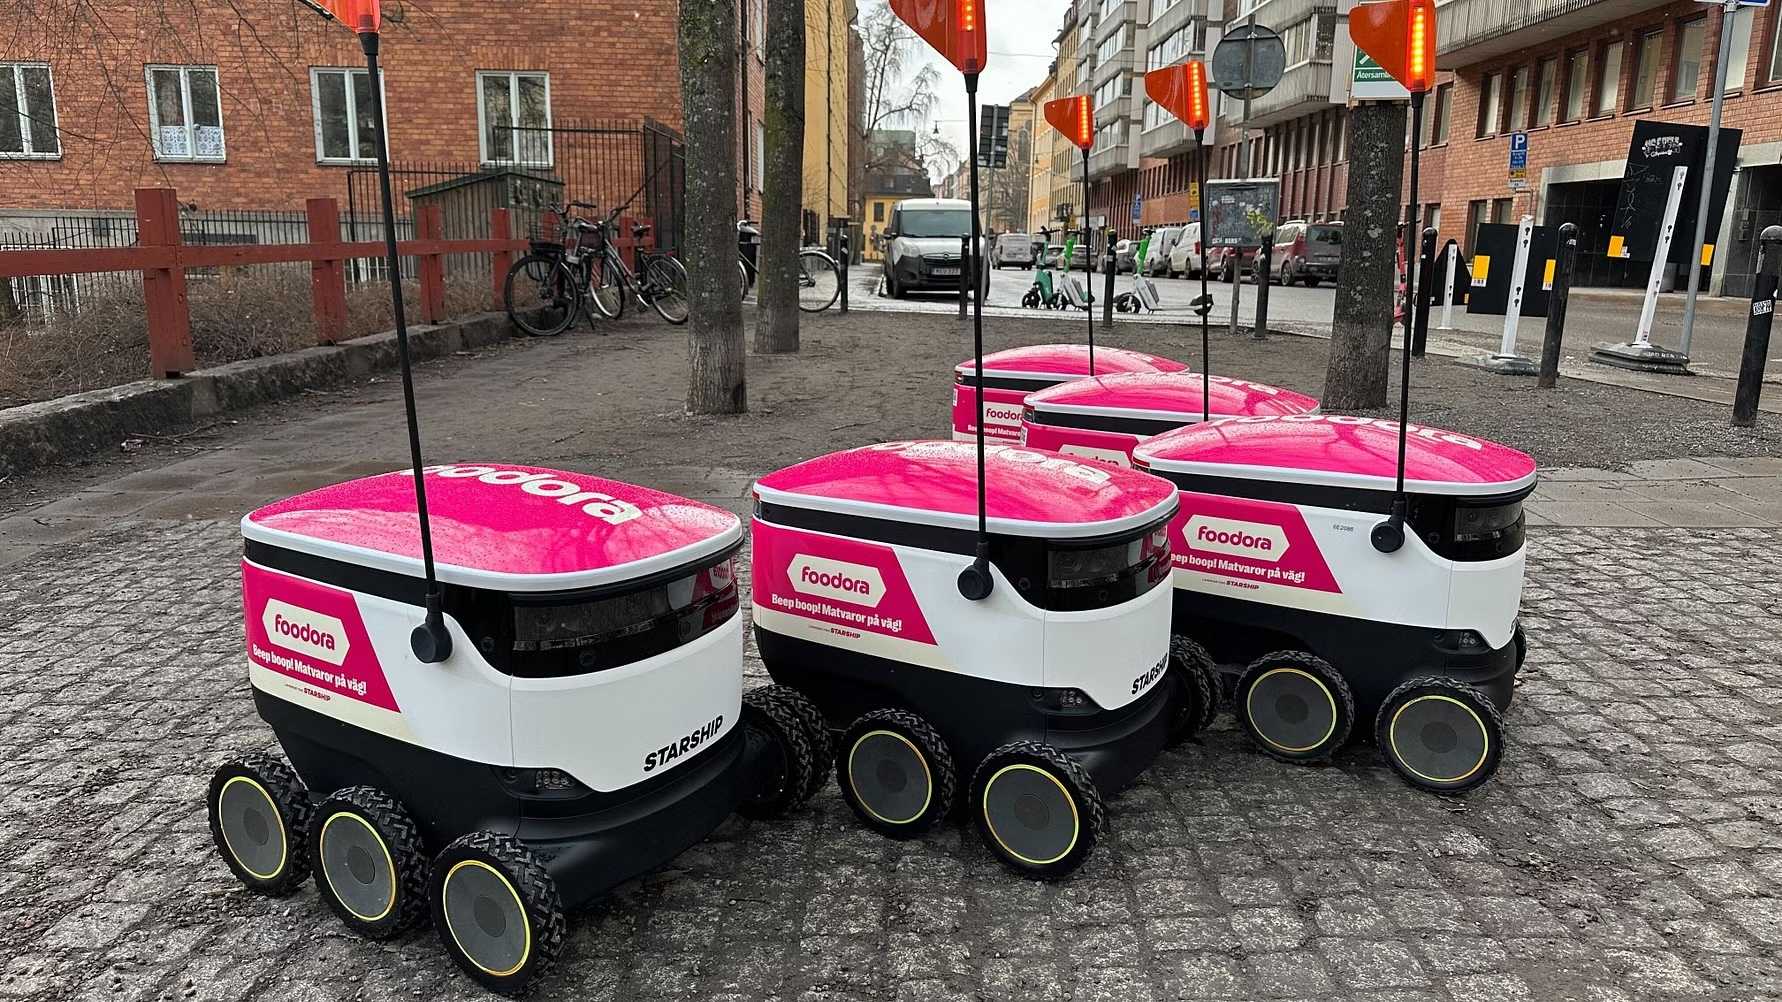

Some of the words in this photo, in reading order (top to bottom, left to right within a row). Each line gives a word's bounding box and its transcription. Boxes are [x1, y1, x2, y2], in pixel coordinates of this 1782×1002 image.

[1515, 135, 1525, 149] P
[1198, 525, 1272, 550] foodora
[801, 566, 870, 595] foodora
[1170, 553, 1188, 564] eep
[1189, 554, 1217, 569] boop!
[1218, 559, 1266, 576] Matvaror
[1267, 567, 1280, 580] på
[1282, 570, 1305, 583] väg!
[1226, 580, 1260, 590] STARSHIP
[771, 594, 794, 609] Beep
[795, 598, 821, 615] boop!
[822, 604, 866, 623] Matvaror
[867, 614, 880, 627] på
[881, 617, 902, 632] väg!
[275, 614, 335, 650] foodora
[831, 627, 861, 639] STARSHIP
[252, 643, 271, 663] Beep
[271, 652, 294, 671] boop!
[295, 659, 334, 683] Matvaror
[335, 674, 346, 688] på
[347, 678, 367, 696] väg!
[303, 687, 331, 701] STARSHIP
[643, 715, 724, 772] STARSHIP
